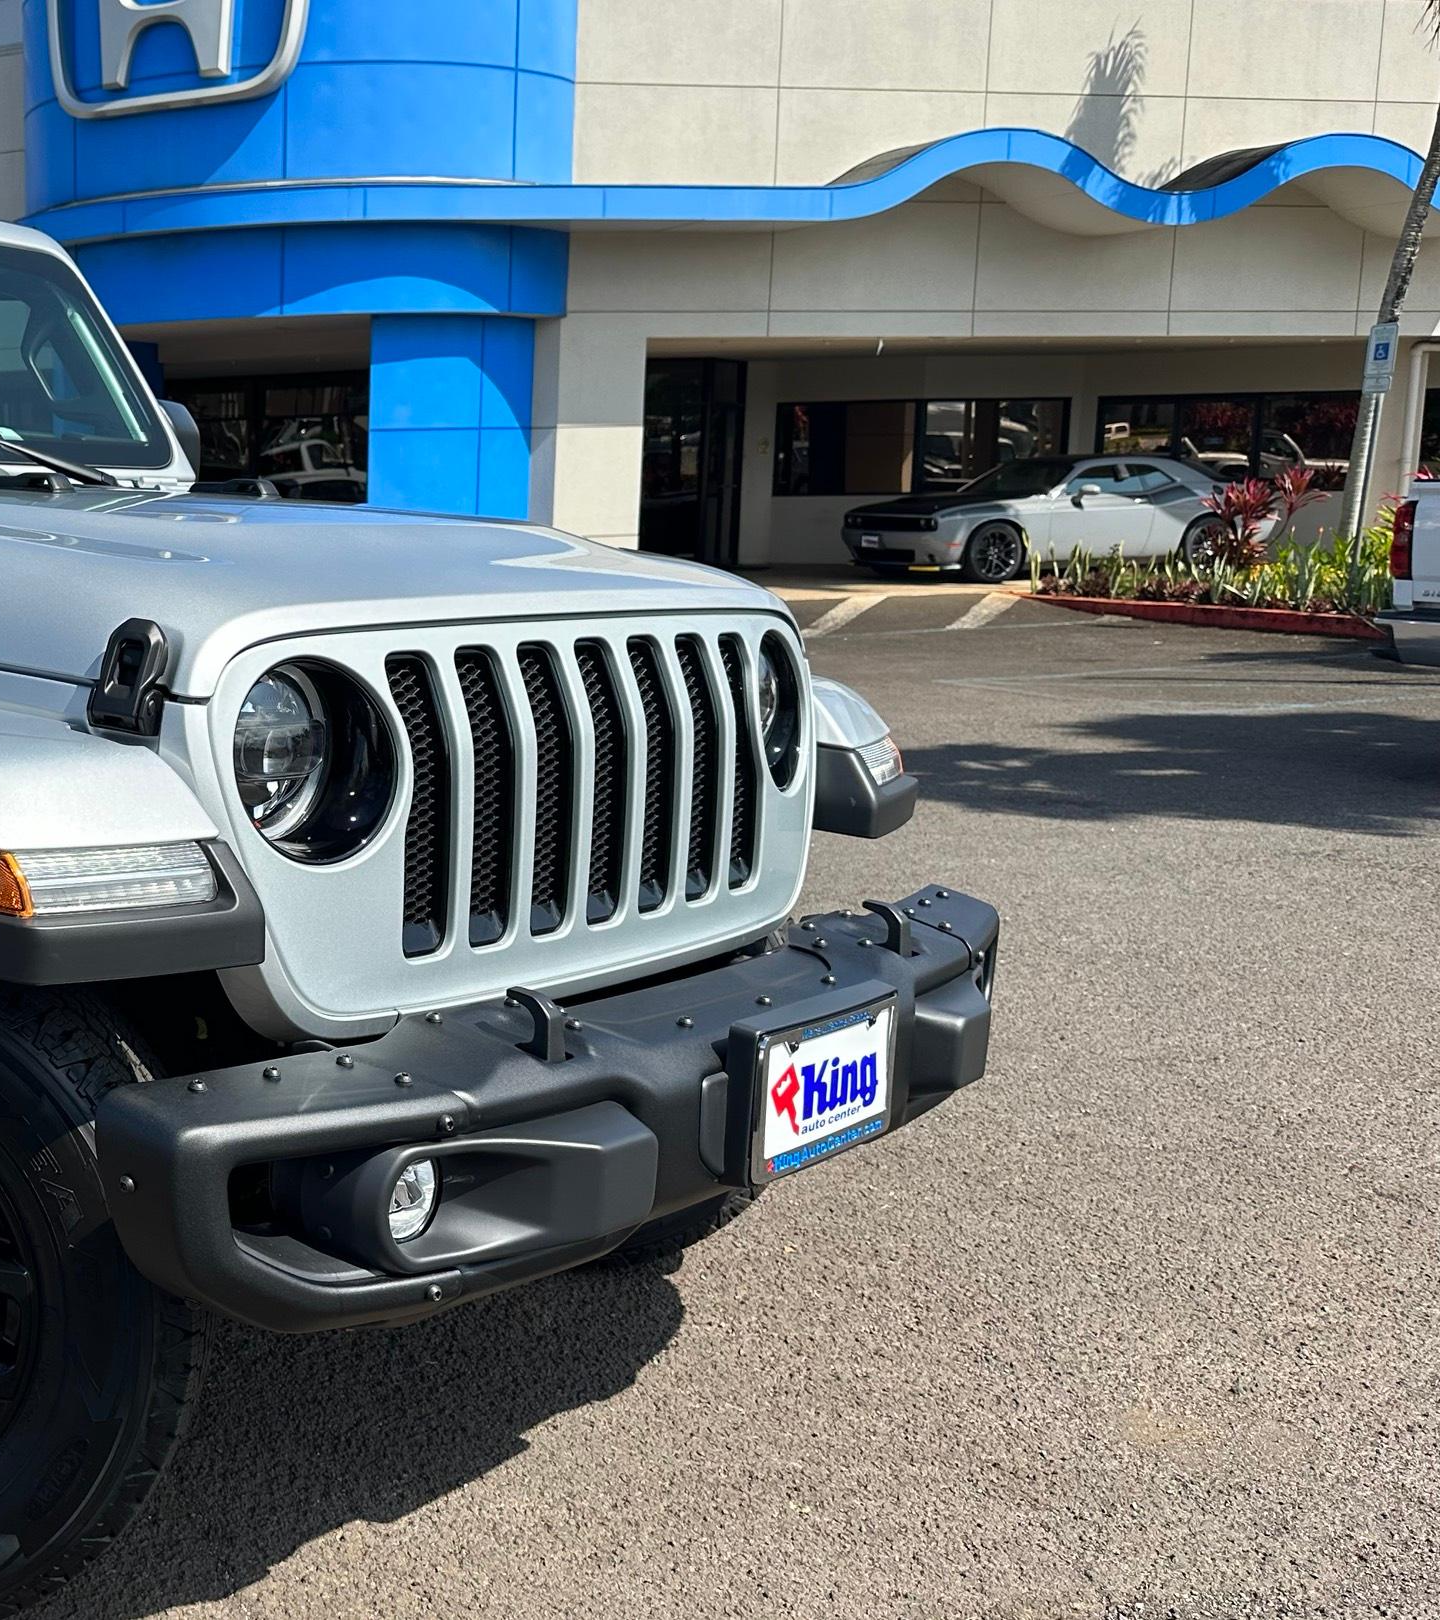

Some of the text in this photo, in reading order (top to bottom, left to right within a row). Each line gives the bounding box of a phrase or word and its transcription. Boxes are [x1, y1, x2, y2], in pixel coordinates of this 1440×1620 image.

[801, 1052, 878, 1121] King
[801, 1104, 861, 1135] auto center
